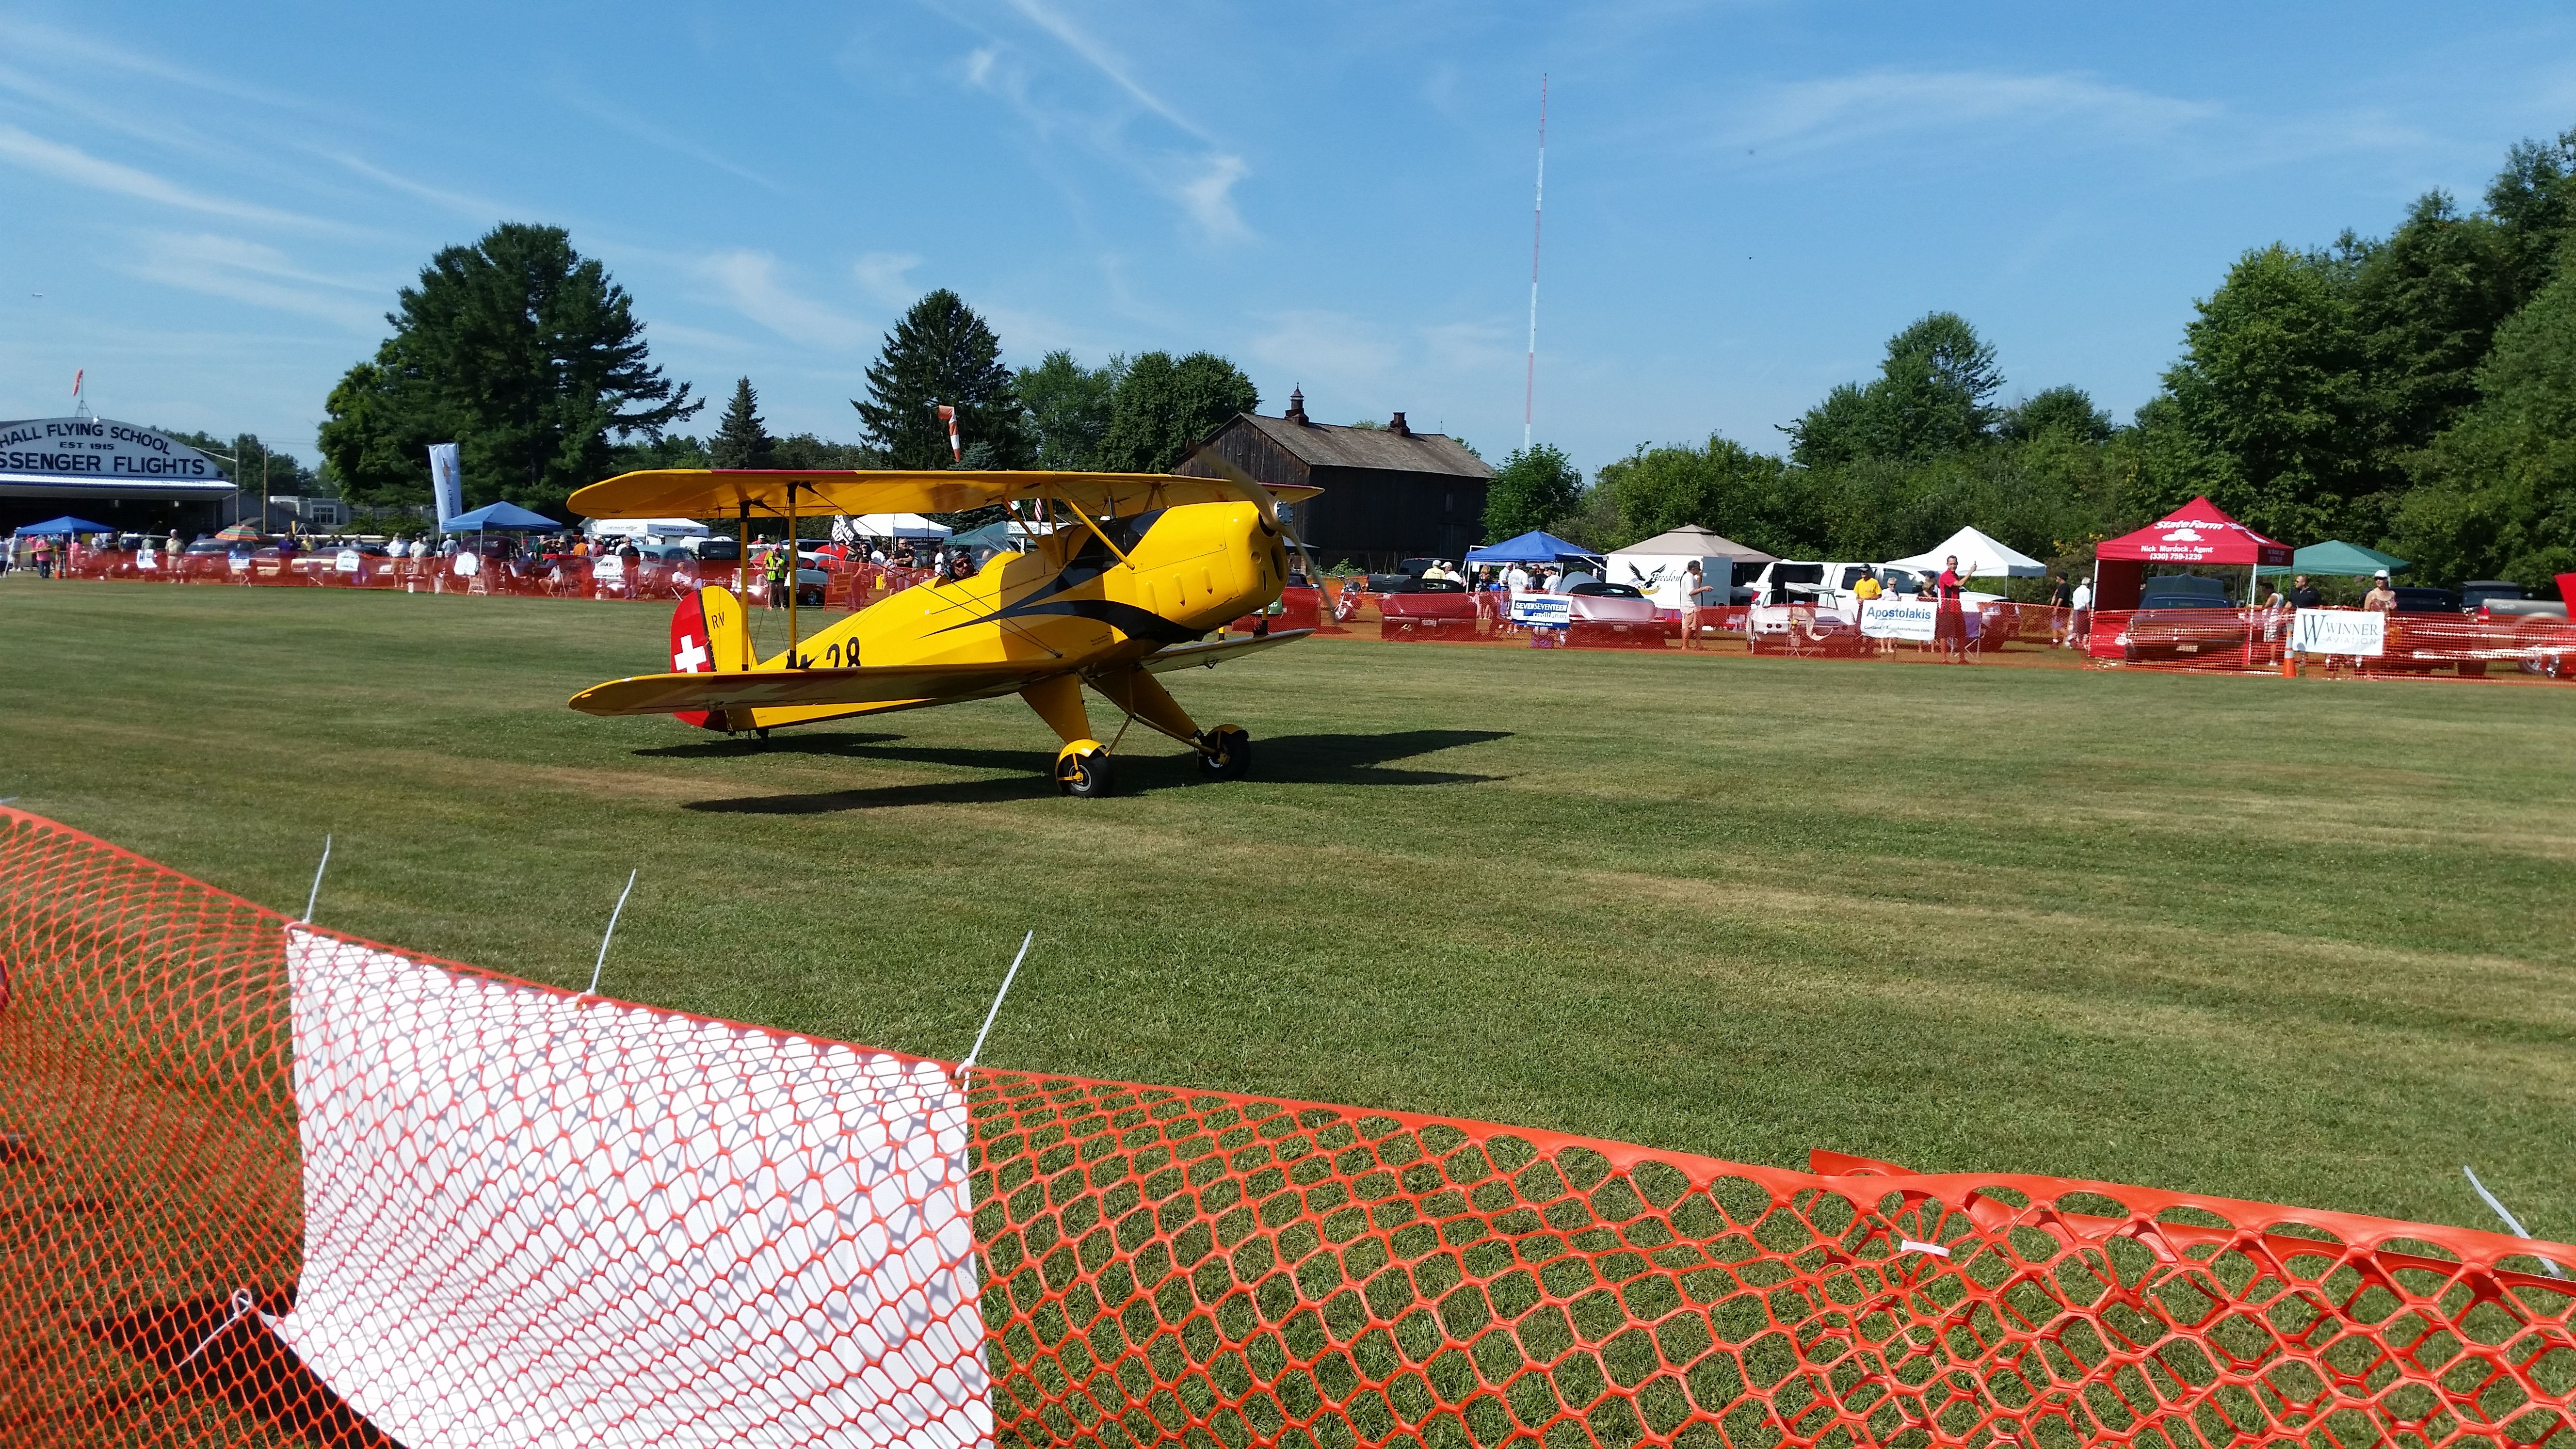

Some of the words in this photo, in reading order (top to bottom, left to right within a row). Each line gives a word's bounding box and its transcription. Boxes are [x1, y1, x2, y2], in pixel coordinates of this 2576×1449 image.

[47, 423, 103, 436] FLYING
[111, 426, 170, 455] SCHOOL
[114, 456, 205, 475] FLIGHTS
[711, 611, 724, 629] RV
[1867, 607, 1931, 619] Apostolakis
[2326, 622, 2378, 636] WINNER
[2326, 636, 2377, 644] AVIATION
[826, 636, 861, 667] 28
